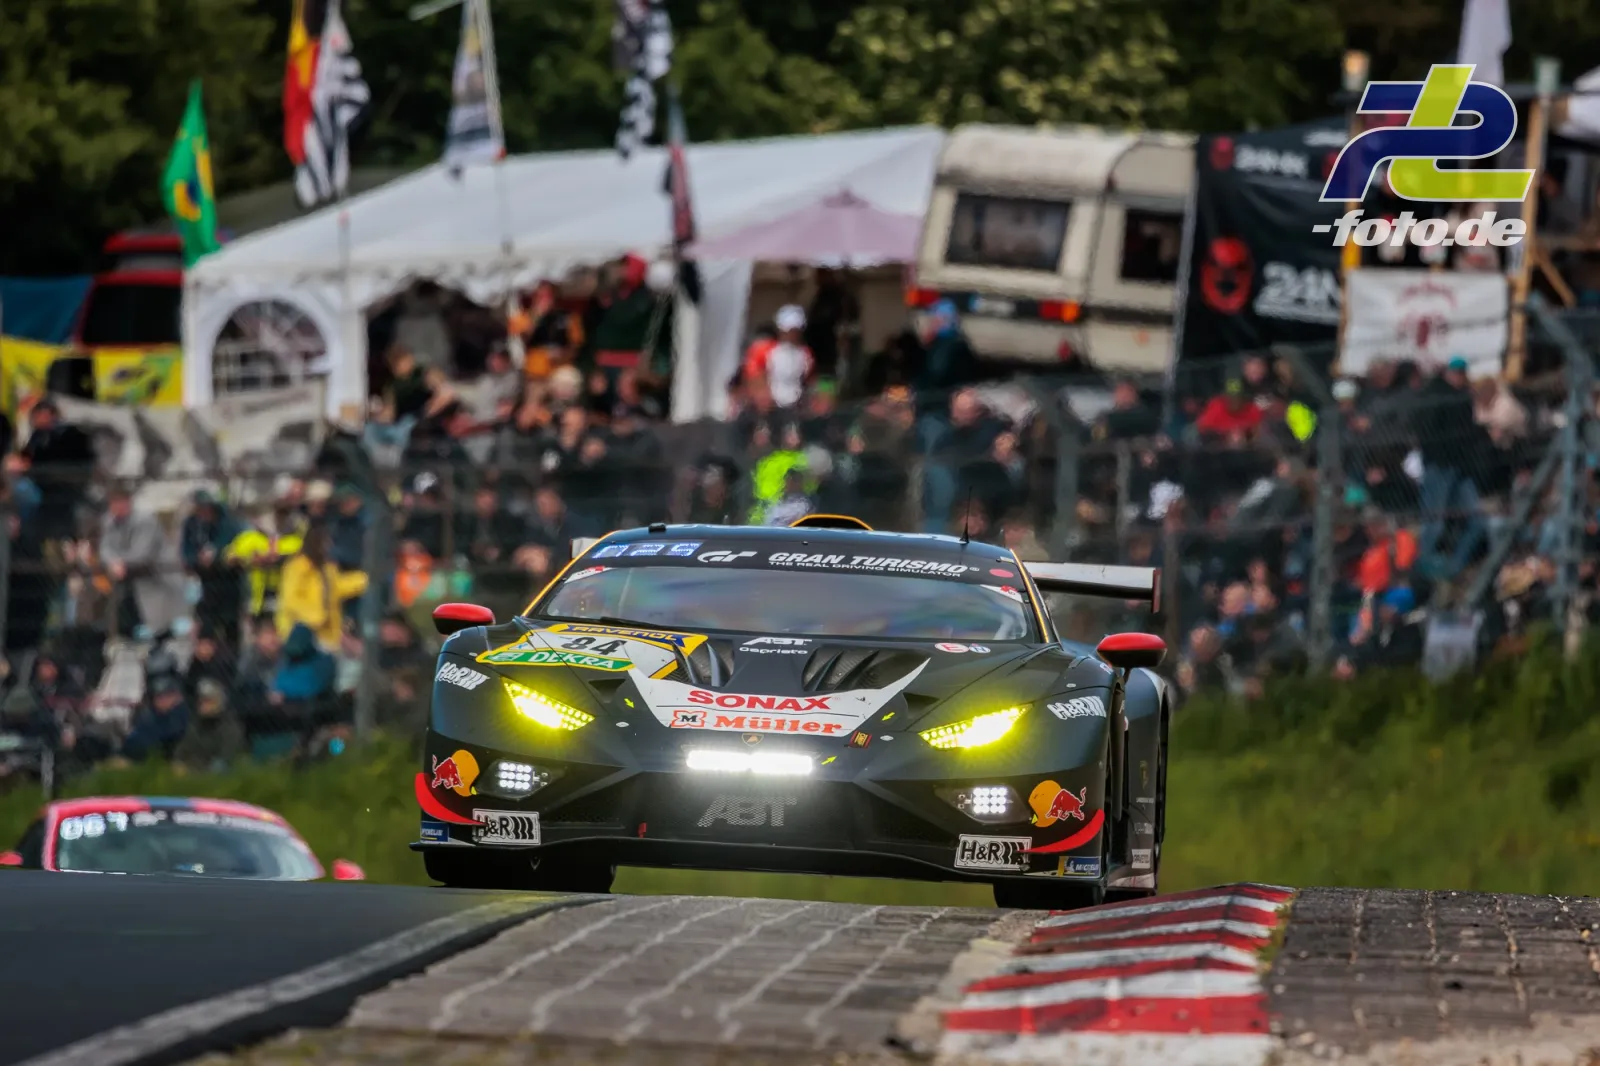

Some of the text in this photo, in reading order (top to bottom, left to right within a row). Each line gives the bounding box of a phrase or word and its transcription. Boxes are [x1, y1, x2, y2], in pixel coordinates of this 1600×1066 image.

[768, 552, 846, 564] GRAN
[832, 563, 885, 571] DRIVING
[887, 567, 961, 577] SIMULATOR
[572, 625, 677, 643] RAVENOL
[742, 636, 813, 646] ABT
[561, 636, 627, 656] 84
[527, 651, 615, 669] DEKRA
[687, 690, 832, 711] SONAX
[680, 714, 698, 723] M
[713, 715, 842, 734] Müller
[697, 794, 798, 828] ABT
